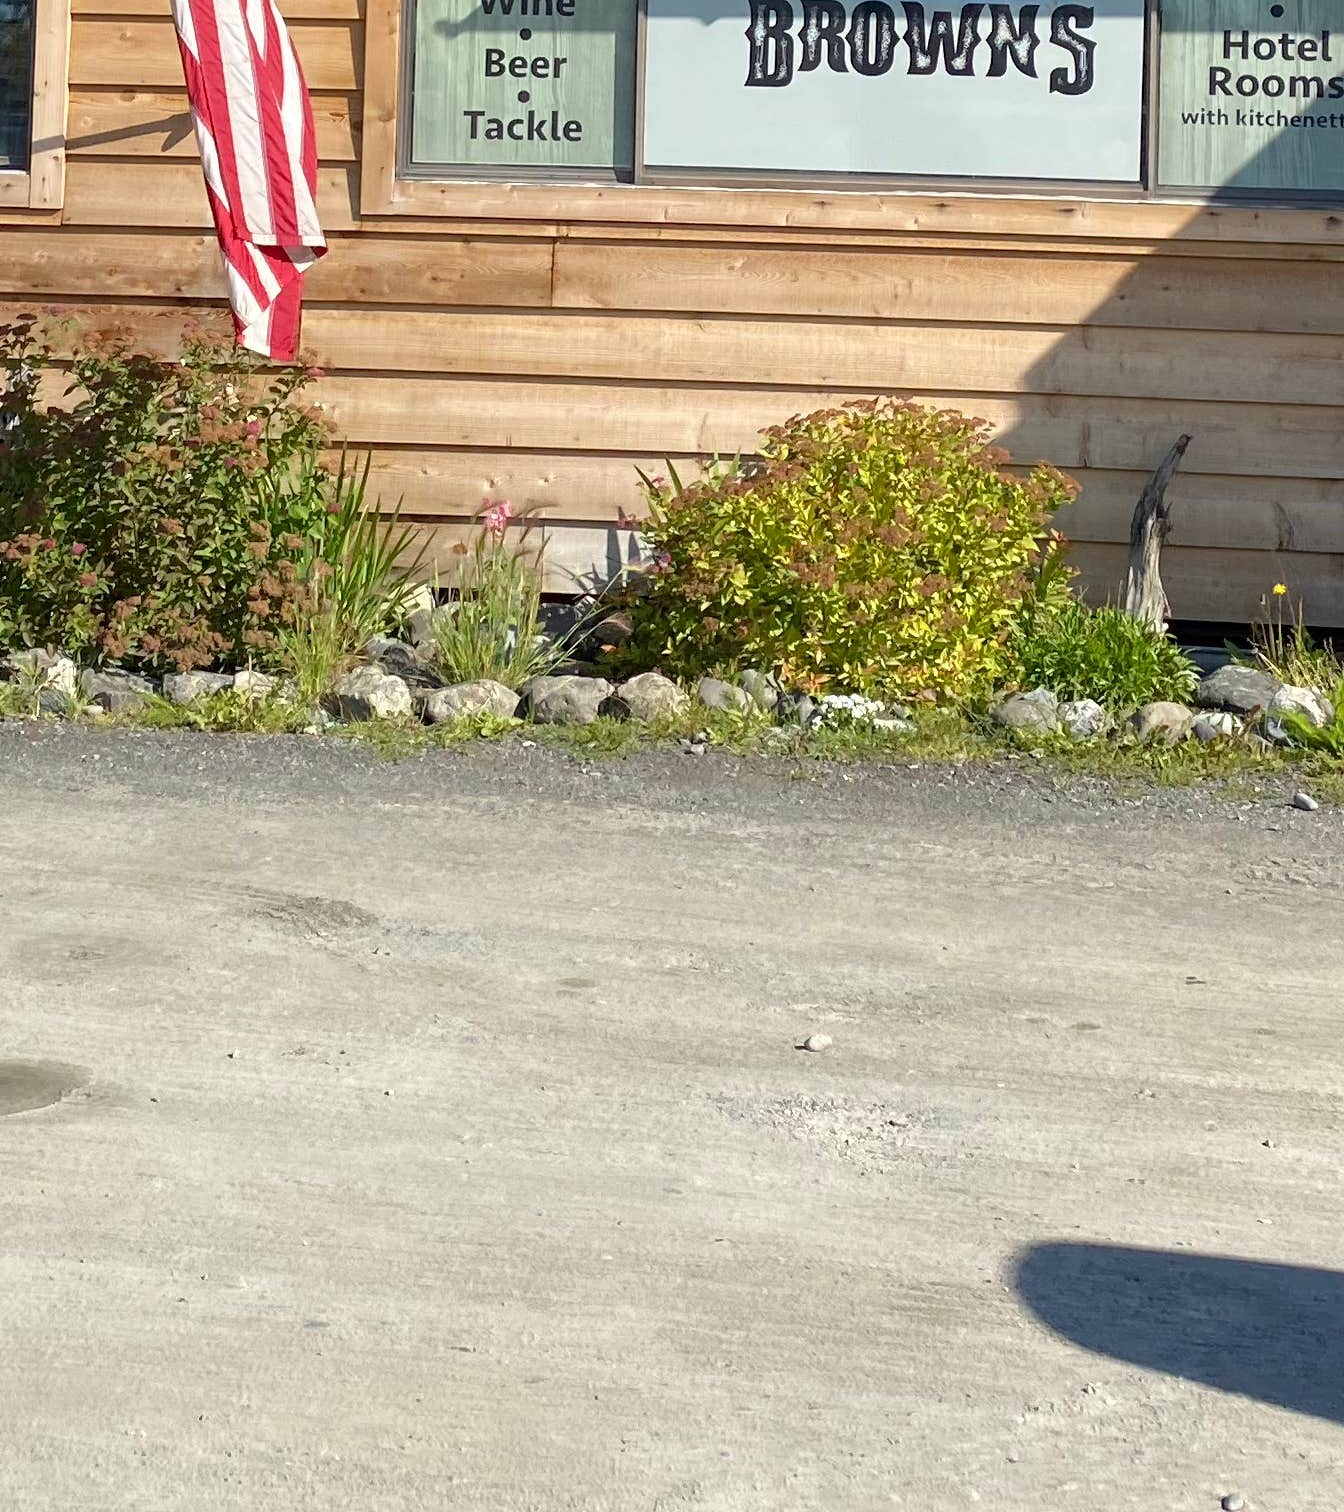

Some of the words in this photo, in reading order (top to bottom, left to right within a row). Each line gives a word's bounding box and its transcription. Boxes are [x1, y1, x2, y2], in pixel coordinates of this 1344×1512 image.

[1222, 30, 1333, 62] Hotel
[484, 48, 568, 79] Beer
[463, 110, 583, 142] Tackle
[1181, 108, 1229, 127] with
